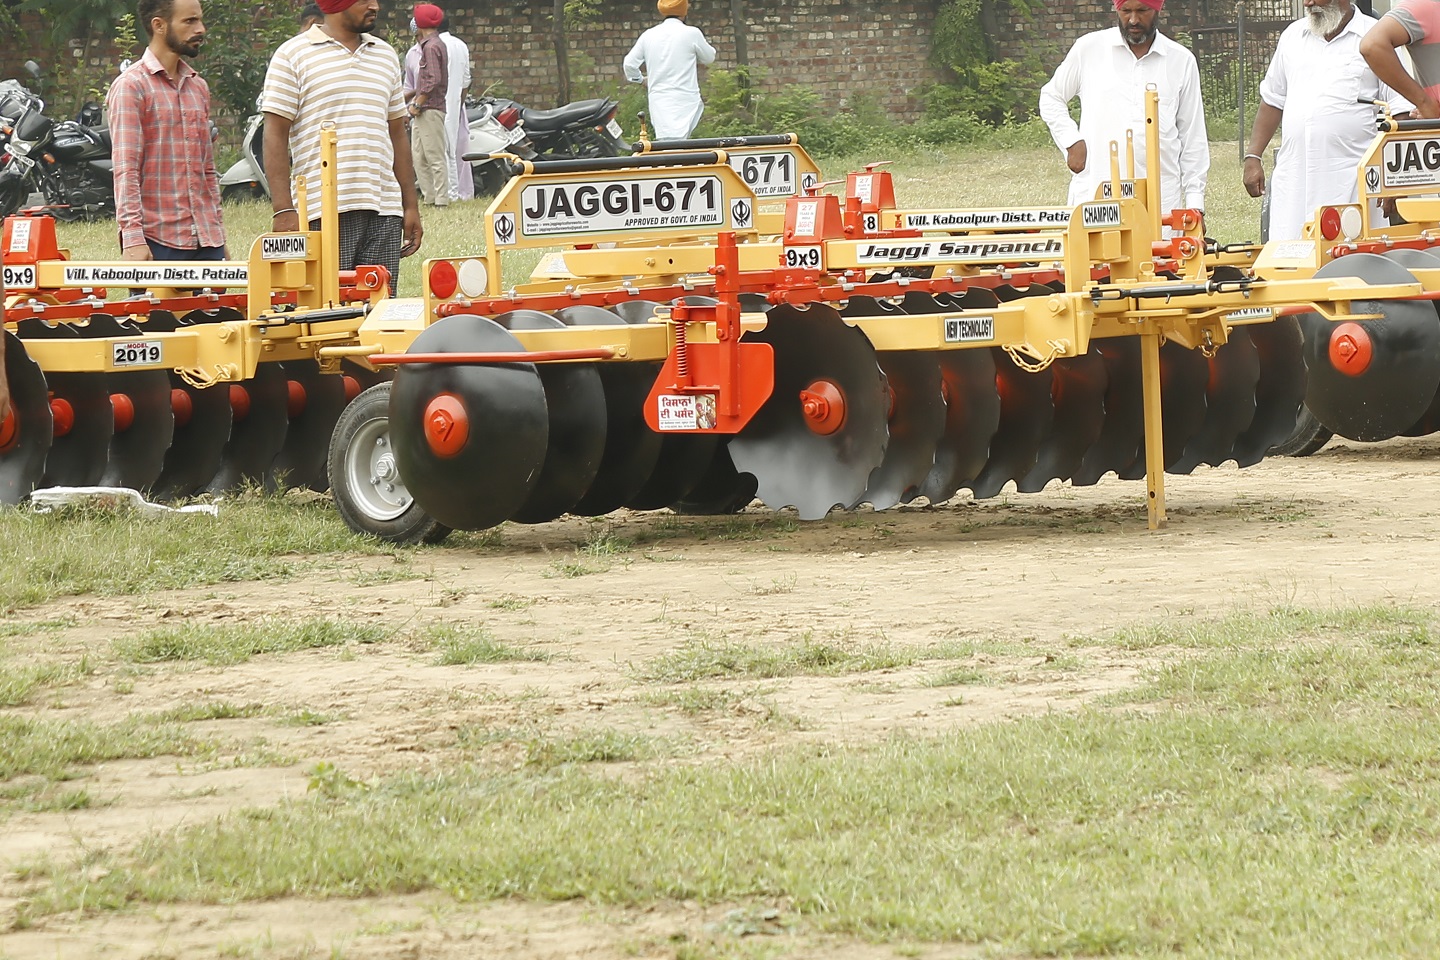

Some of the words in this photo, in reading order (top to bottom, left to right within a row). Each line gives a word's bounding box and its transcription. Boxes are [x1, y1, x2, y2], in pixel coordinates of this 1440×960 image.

[524, 179, 716, 219] JAGGI-671
[624, 217, 659, 227] APPROVED
[660, 217, 669, 225] BY
[670, 216, 688, 224] GOVT.
[689, 215, 698, 223] OF
[699, 214, 717, 222] INDIA
[908, 216, 929, 226] Vill.
[1001, 212, 1036, 223] Distt.
[1038, 211, 1070, 222] Patia
[1084, 205, 1119, 224] CHAMPION
[263, 238, 304, 253] CHAMPION
[860, 243, 931, 261] Jaggi
[938, 239, 1062, 259] Sarpanch
[786, 248, 819, 267] 9x9
[4, 268, 33, 286] 9x9
[66, 268, 89, 281] Vill.
[163, 267, 199, 280] Distt.
[202, 267, 248, 280] Patiala
[115, 346, 160, 362] 2019
